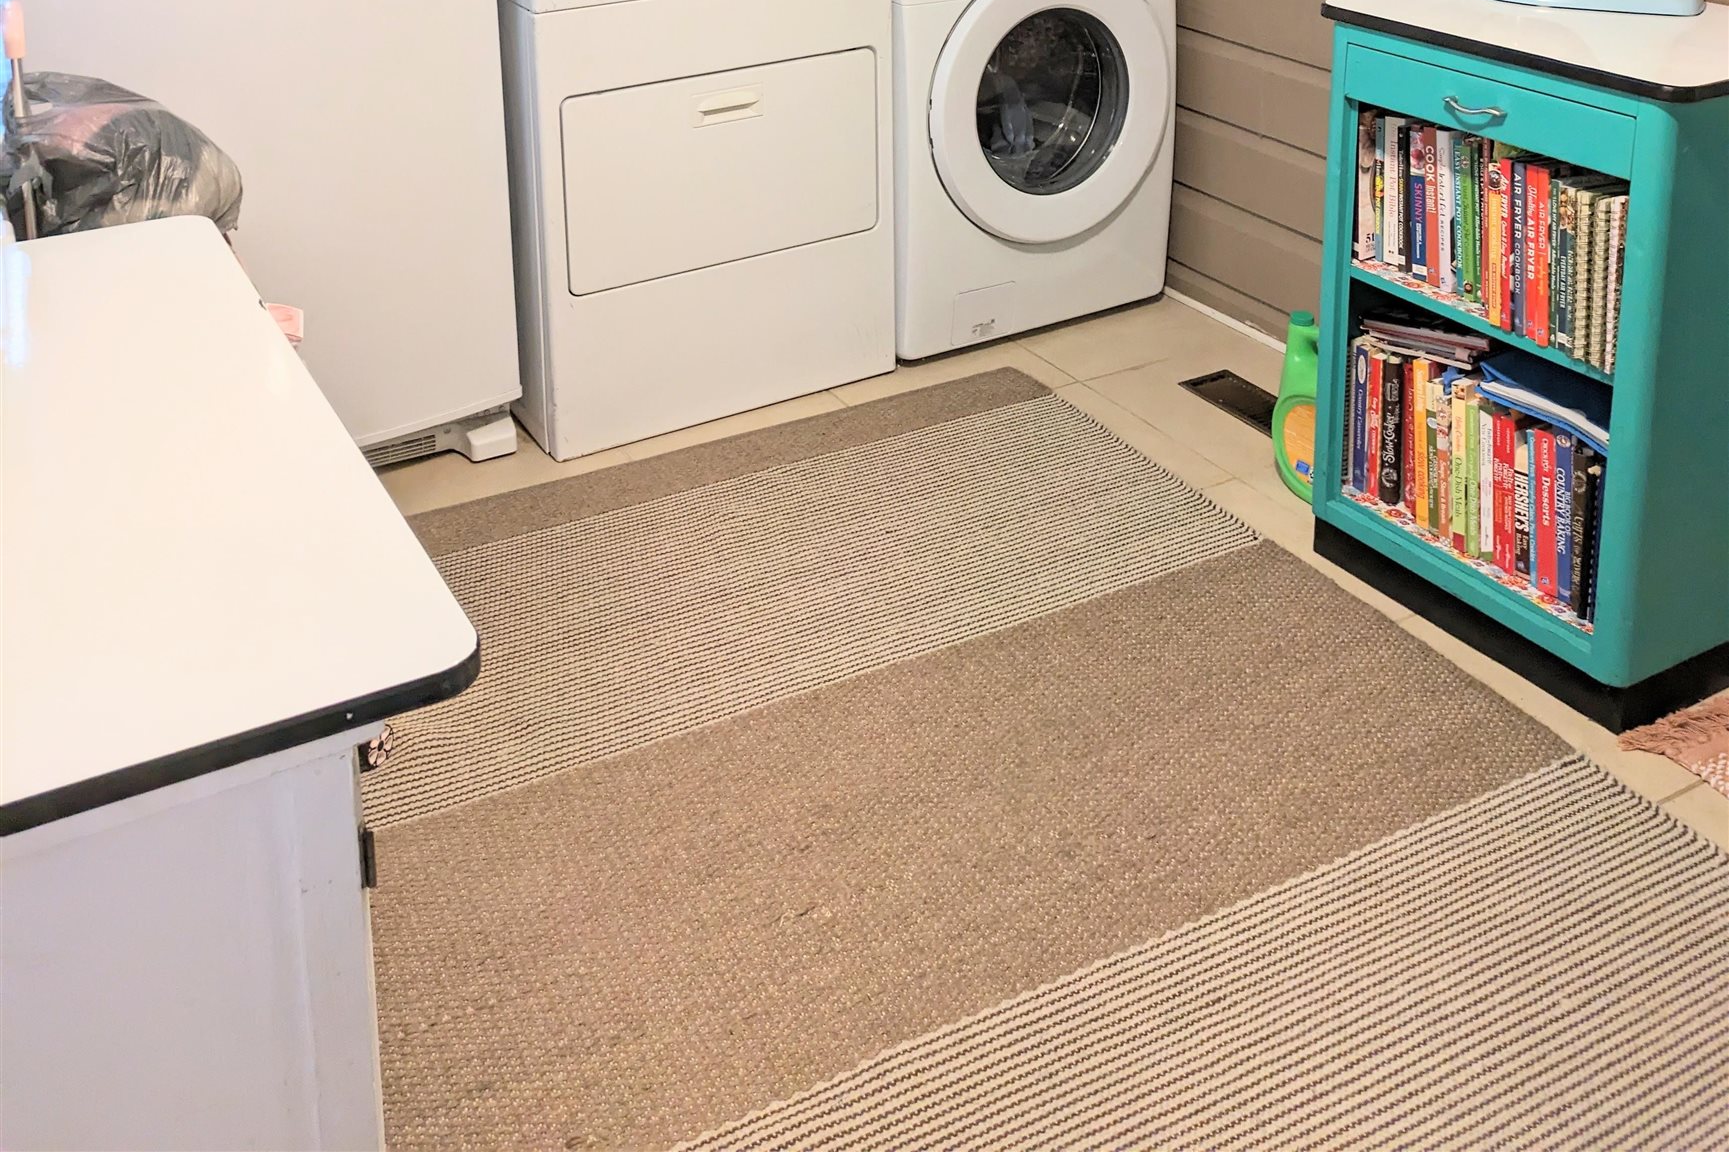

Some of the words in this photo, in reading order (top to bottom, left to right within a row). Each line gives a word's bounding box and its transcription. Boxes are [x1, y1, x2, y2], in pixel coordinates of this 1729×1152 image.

[1426, 145, 1435, 183] COOK
[1414, 182, 1423, 223] SKINNY
[1514, 173, 1522, 195] AIR
[1527, 185, 1538, 217] Healthy
[1514, 199, 1522, 239] FRYER
[1527, 217, 1535, 239] AIR
[1527, 241, 1535, 280] FRYER
[1356, 388, 1364, 415] Country
[1455, 495, 1463, 517] Meals
[1514, 473, 1529, 532] HERSHEY'S
[1541, 475, 1551, 527] Desserts
[1556, 467, 1566, 516] COUNTRY
[1514, 532, 1522, 555] Baking
[1556, 516, 1566, 555] BAKING
[1565, 525, 1571, 536] OF
